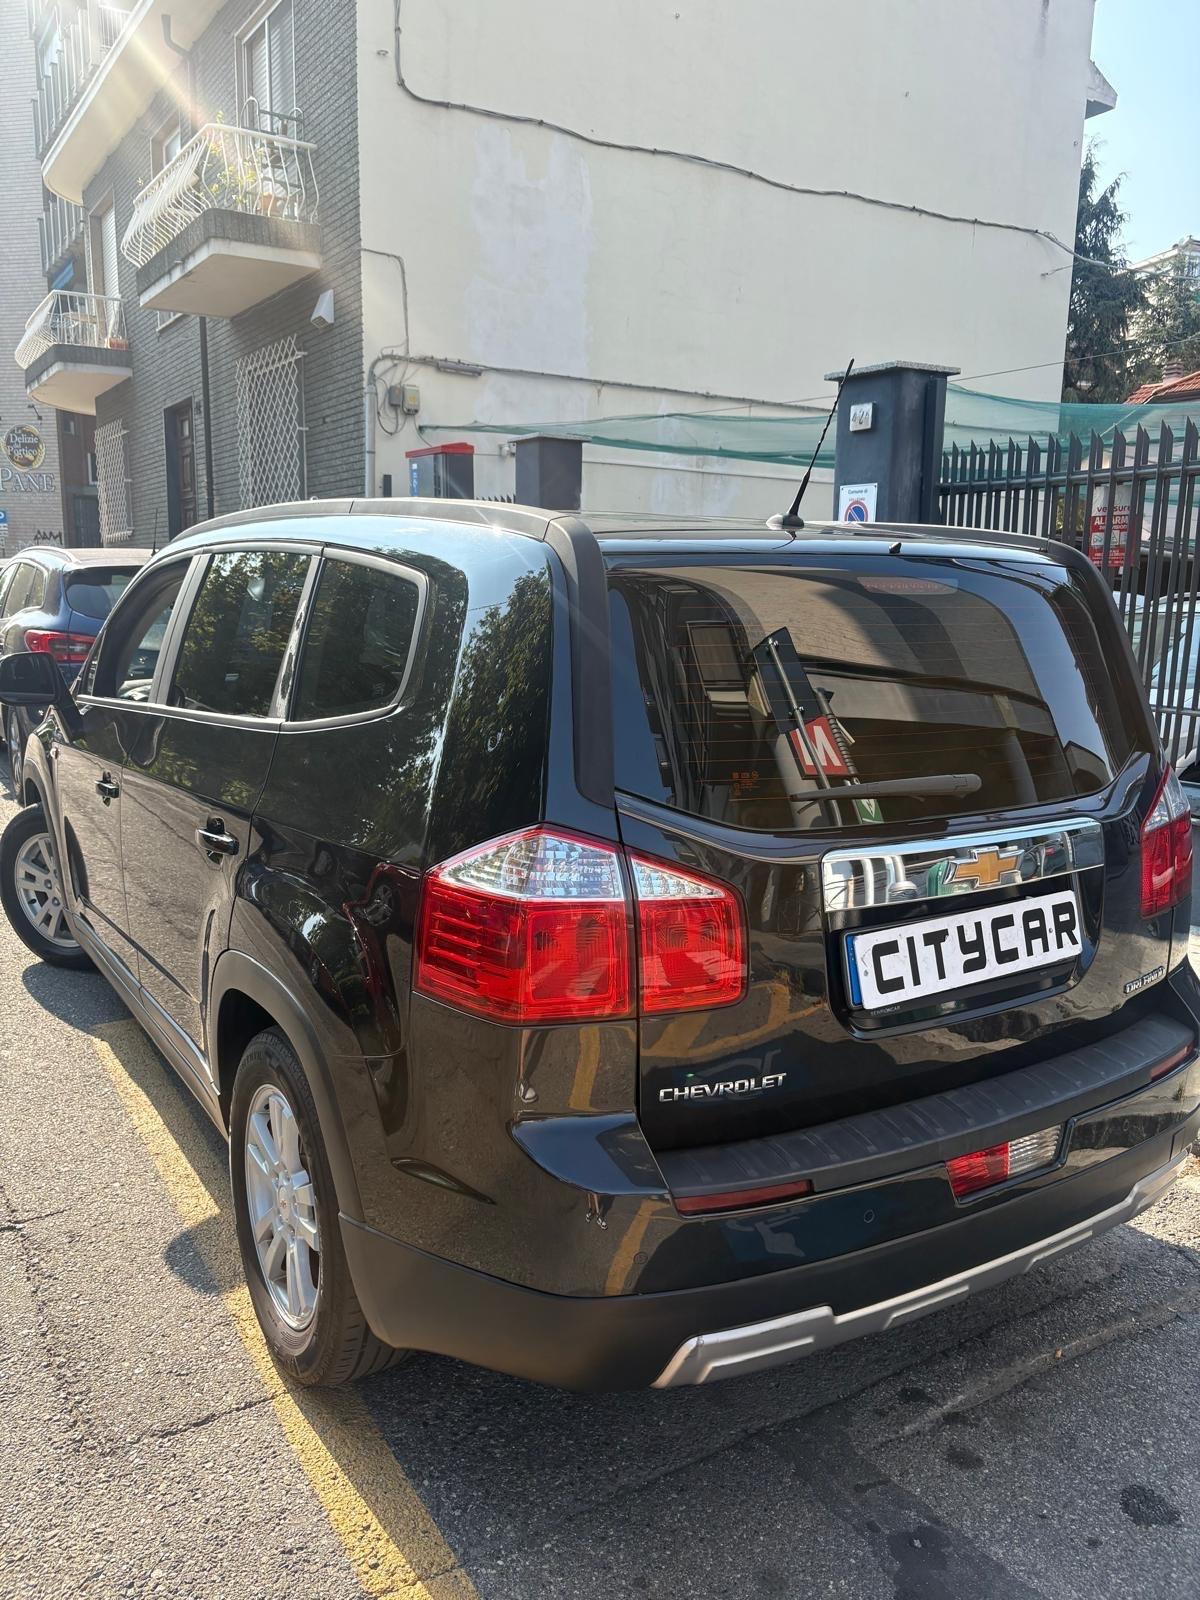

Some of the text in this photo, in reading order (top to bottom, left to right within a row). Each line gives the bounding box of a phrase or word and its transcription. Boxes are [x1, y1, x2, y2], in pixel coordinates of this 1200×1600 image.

[10, 433, 39, 443] Delizie
[7, 446, 38, 456] Portico
[0, 467, 56, 492] PANE
[1096, 505, 1130, 513] vesur
[872, 901, 1079, 995] CITYCAR
[659, 1073, 787, 1102] CHEVROLET
